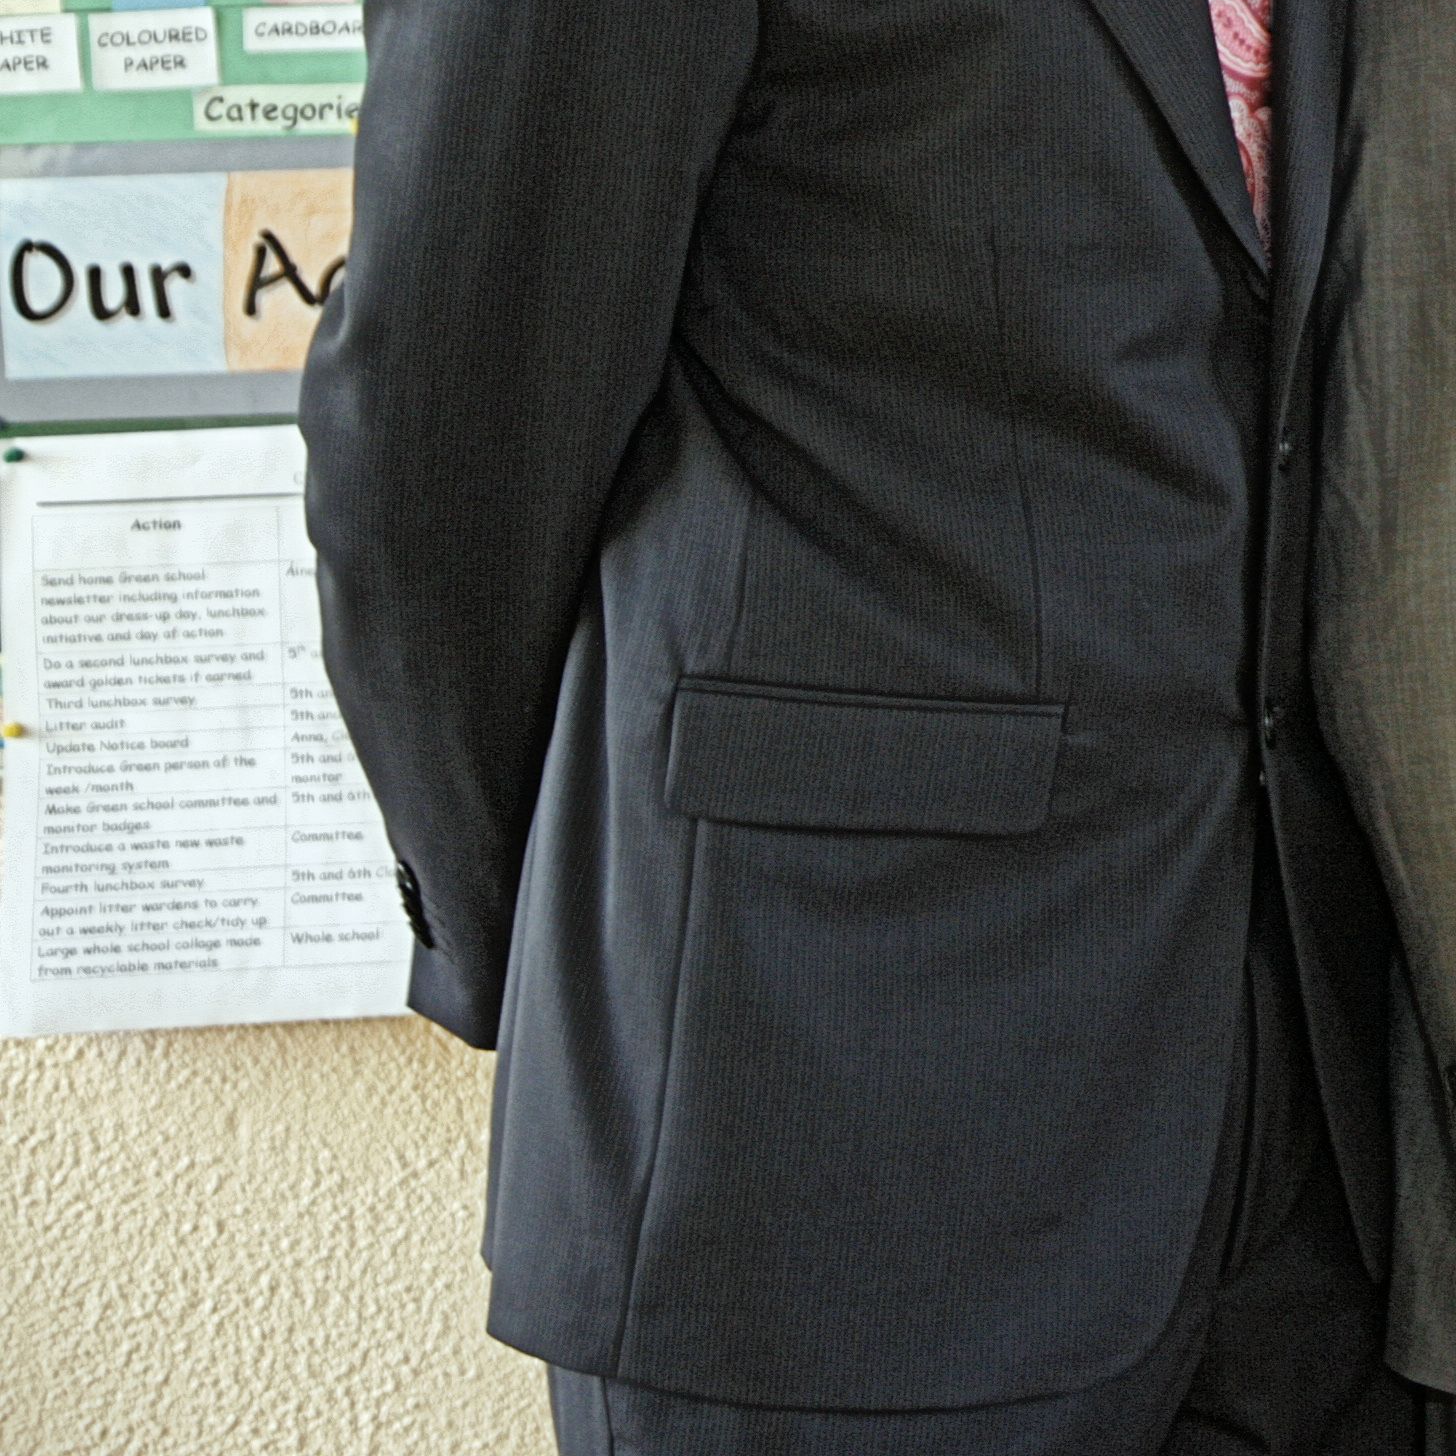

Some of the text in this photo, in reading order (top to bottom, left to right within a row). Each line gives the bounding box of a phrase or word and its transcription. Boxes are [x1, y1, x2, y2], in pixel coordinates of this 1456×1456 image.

[96, 26, 209, 49] COLOURED
[253, 20, 364, 38] CARDBOAR
[123, 55, 188, 73] PAPER
[203, 94, 361, 131] Categorie
[10, 237, 193, 322] Our
[130, 518, 183, 532] Action
